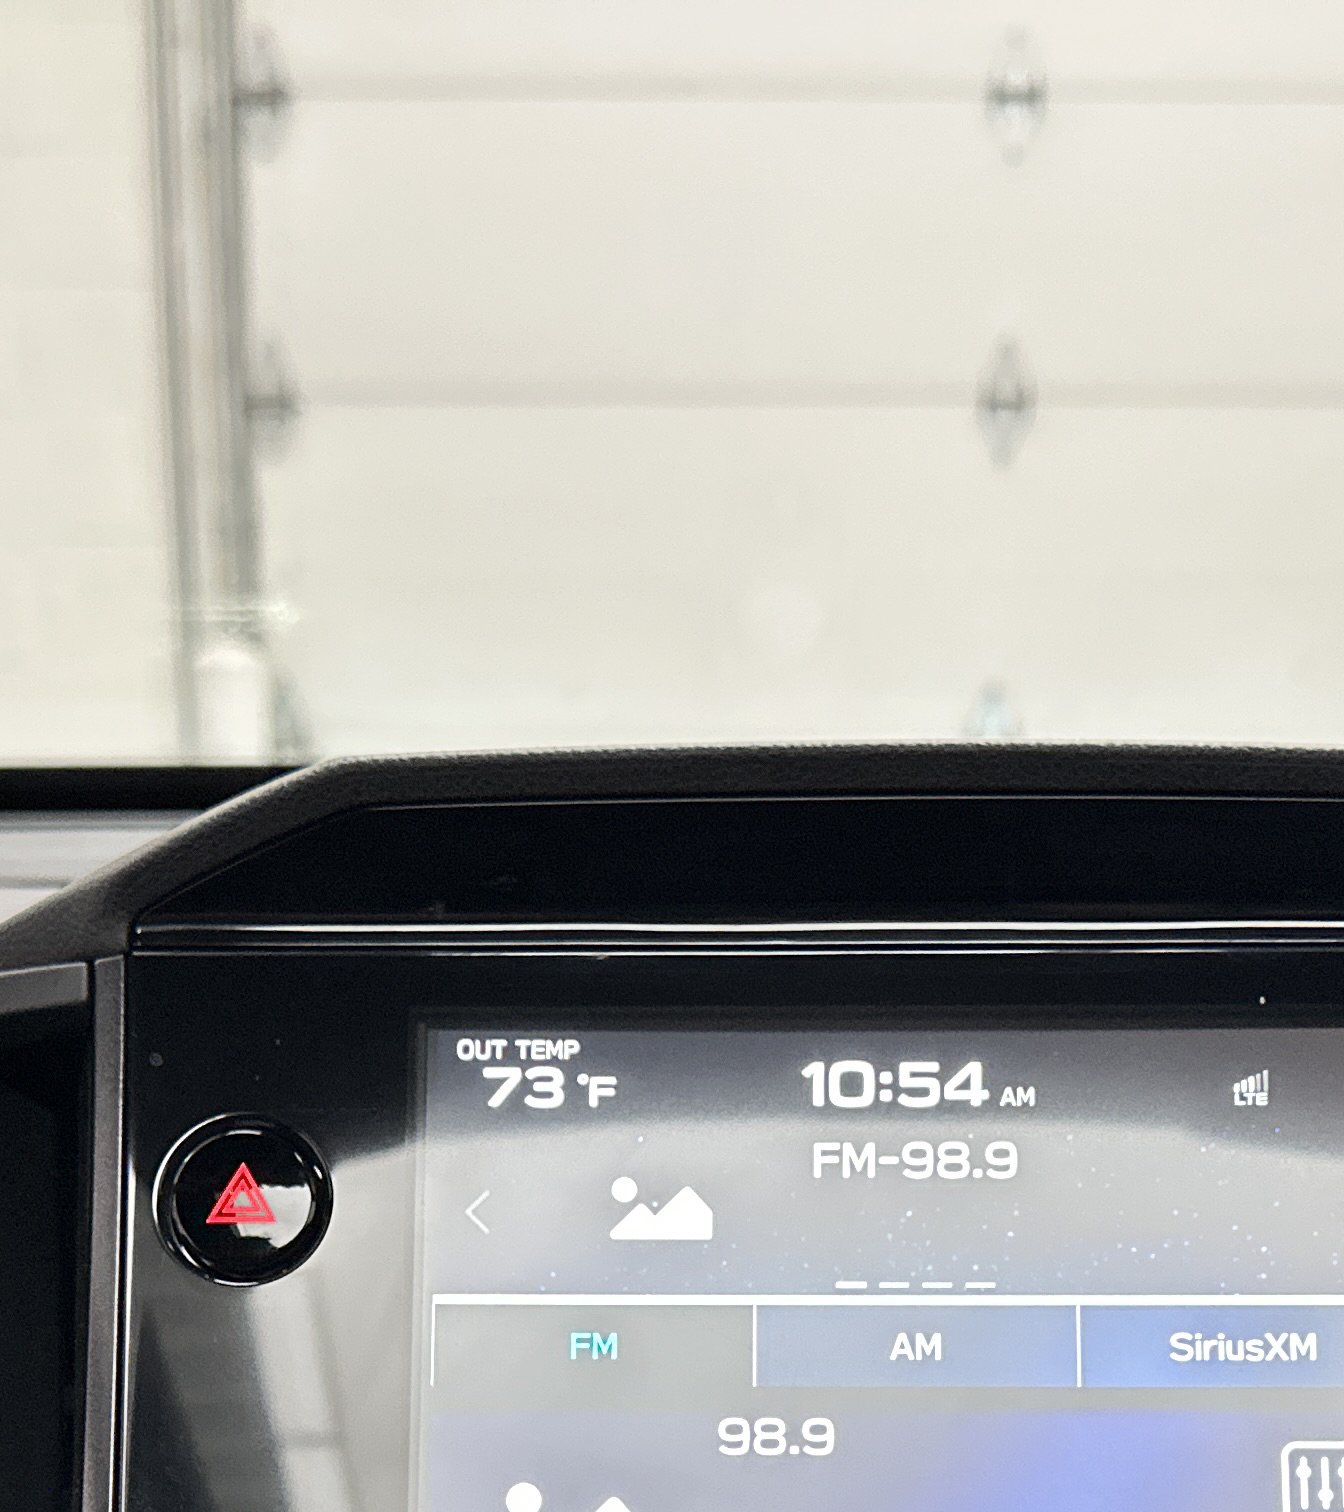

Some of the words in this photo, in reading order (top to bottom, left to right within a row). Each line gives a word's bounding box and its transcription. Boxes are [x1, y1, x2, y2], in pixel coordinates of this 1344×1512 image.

[456, 1038, 507, 1061] OUT
[515, 1039, 581, 1060] TEMP
[482, 1065, 566, 1109] 73
[801, 1060, 990, 1108] 10:54
[999, 1086, 1037, 1107] AM
[1233, 1092, 1269, 1106] LTE
[812, 1140, 1019, 1180] FM-98.9
[569, 1332, 619, 1361] FM
[889, 1332, 943, 1361] AM
[1168, 1331, 1318, 1362] SiriusXM
[716, 1416, 836, 1456] 98.9
